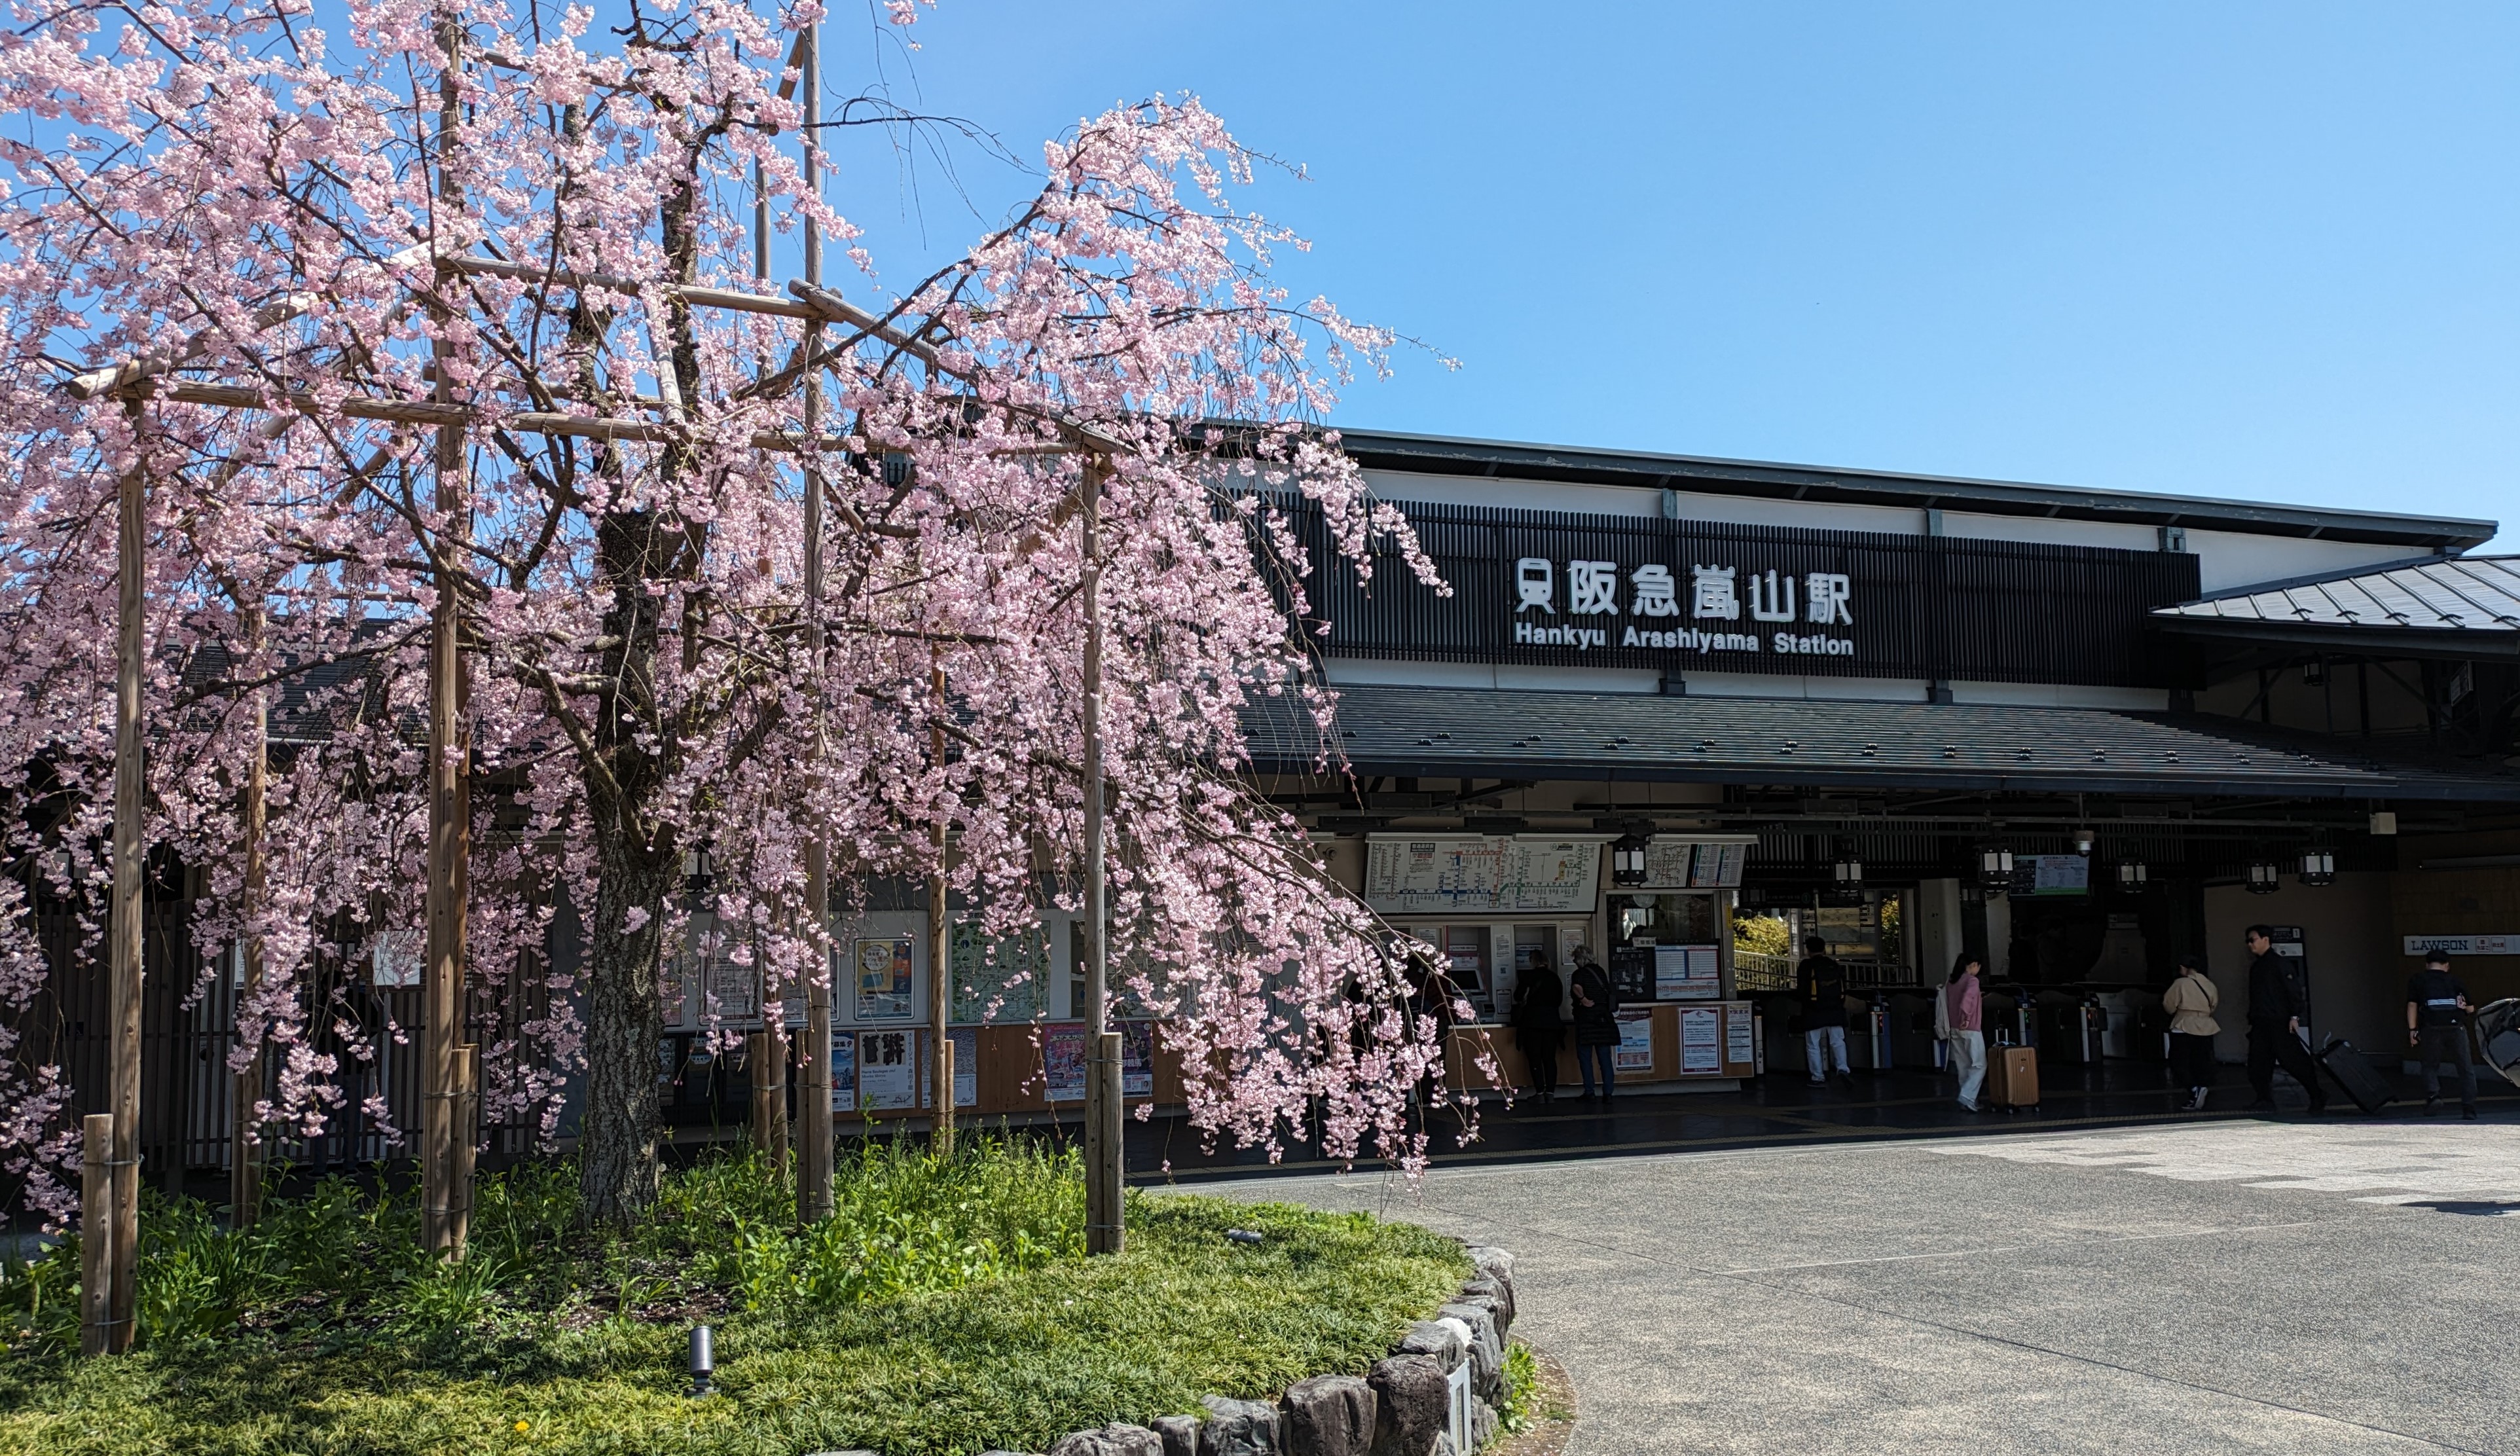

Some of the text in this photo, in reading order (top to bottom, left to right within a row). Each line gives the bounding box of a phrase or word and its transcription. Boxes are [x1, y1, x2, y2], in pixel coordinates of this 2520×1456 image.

[1567, 560, 1853, 626] 阪急嵐山駅
[1515, 622, 1853, 655] Hankyu Arashiyama Station
[2411, 939, 2468, 951] LAWSON
